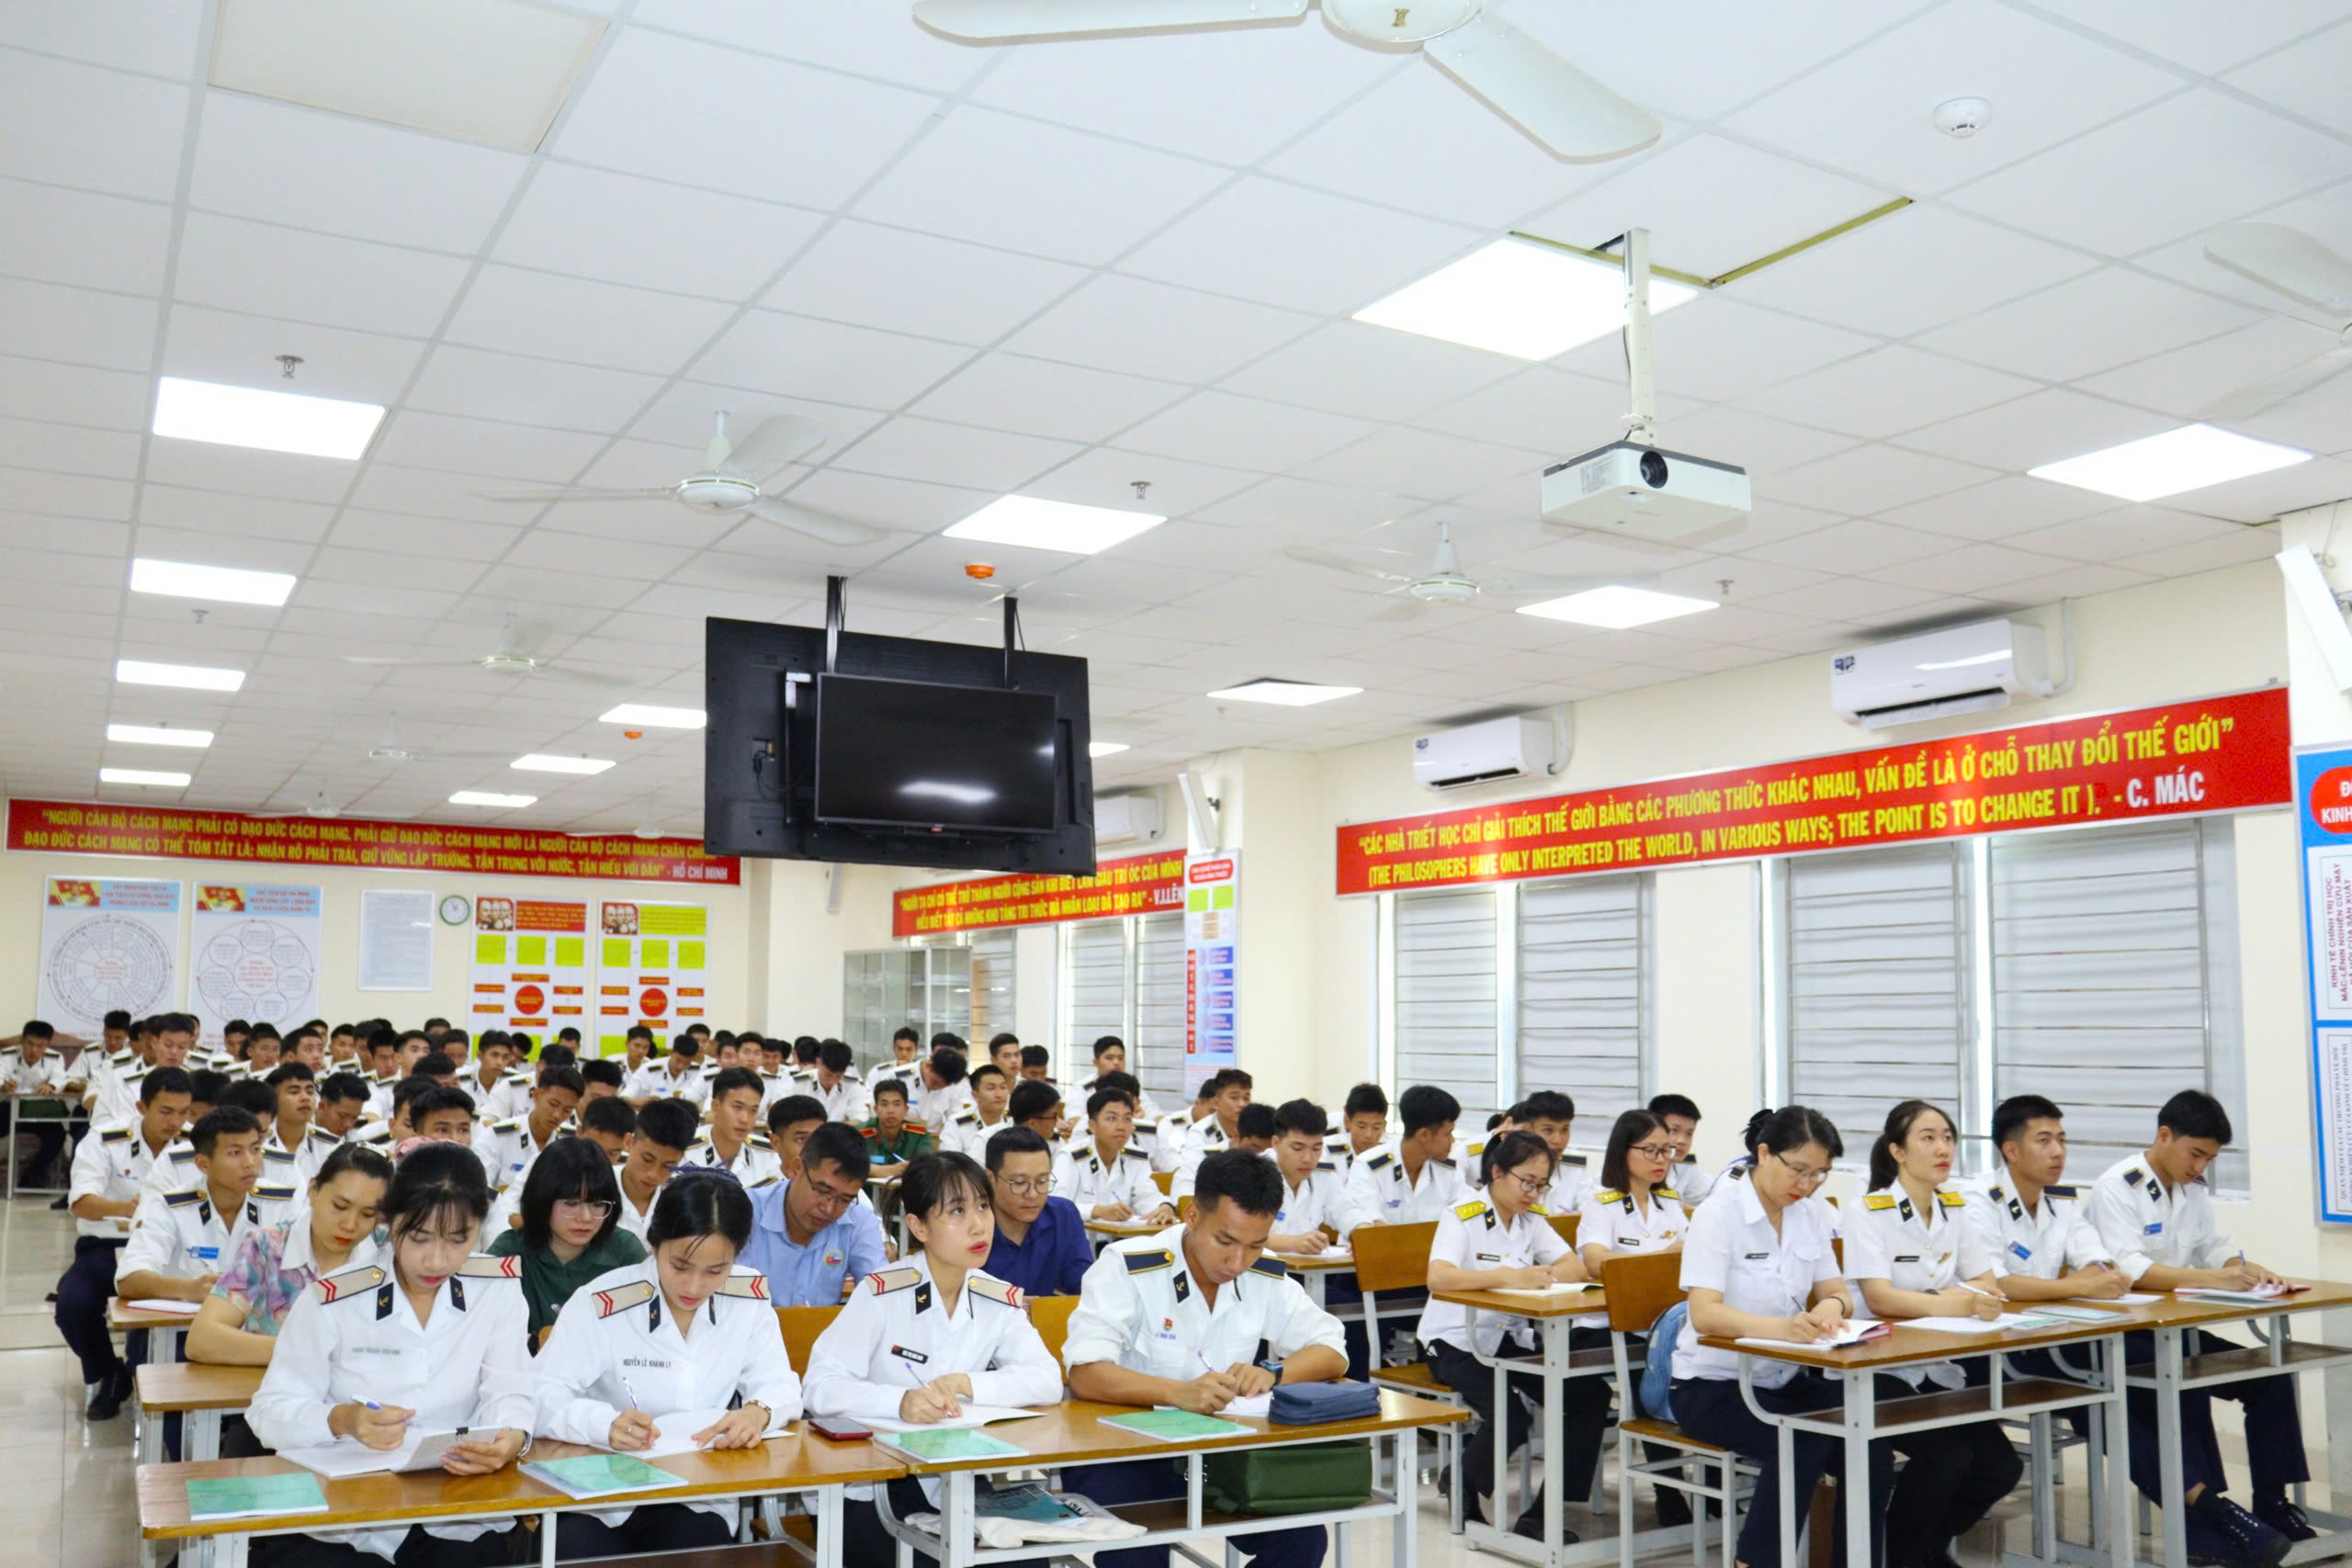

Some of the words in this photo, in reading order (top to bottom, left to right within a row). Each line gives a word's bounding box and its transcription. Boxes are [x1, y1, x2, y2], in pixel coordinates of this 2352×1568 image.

[1369, 864, 1391, 887] (THE
[1393, 857, 1467, 883] PHILOSOPHERS
[1470, 852, 1498, 875] HAVE
[1500, 850, 1530, 873] ONLY
[1532, 840, 1613, 870] INTERPRETED
[1616, 837, 1642, 862] THE
[1645, 831, 1698, 859] WORLD,
[1702, 829, 1715, 853] IN
[1719, 821, 1781, 851] VARIOUS
[1784, 815, 1834, 845] WAYS;
[1838, 810, 1871, 839] THE
[1874, 804, 1924, 834] POINT
[1929, 801, 1948, 829] IS
[1951, 797, 1976, 827] TO
[1980, 788, 2056, 824] CHANGE
[2062, 785, 2080, 814] IT
[2127, 778, 2149, 808] C.
[2154, 764, 2205, 806] MÁC
[1385, 828, 1405, 852] NHÀ
[1408, 820, 1436, 850] TRIẾT
[1439, 825, 1460, 850] HỌC
[1463, 815, 1481, 843] CHỈ
[1483, 810, 1505, 841] GIẢI
[1508, 809, 1542, 838] THÍCH
[1544, 801, 1569, 833] THẾ
[1571, 801, 1596, 830] GIỚI
[1599, 795, 1634, 827] BẰNG
[1636, 794, 1662, 822] CÁC
[1724, 779, 1763, 811] THỨC
[1768, 773, 1809, 806] KHÁC
[1813, 771, 1861, 800] NHAU,
[1865, 756, 1899, 794] VẤN
[1903, 750, 1927, 789] ĐỀ
[1933, 750, 1956, 785] LÀ
[1962, 743, 1976, 782] Ở
[1980, 735, 2018, 779] CHỖ
[2024, 740, 2075, 773] THAY
[2082, 719, 2118, 766] ĐỔI
[2123, 716, 2168, 761] THẾ
[2321, 806, 2352, 824] KINH
